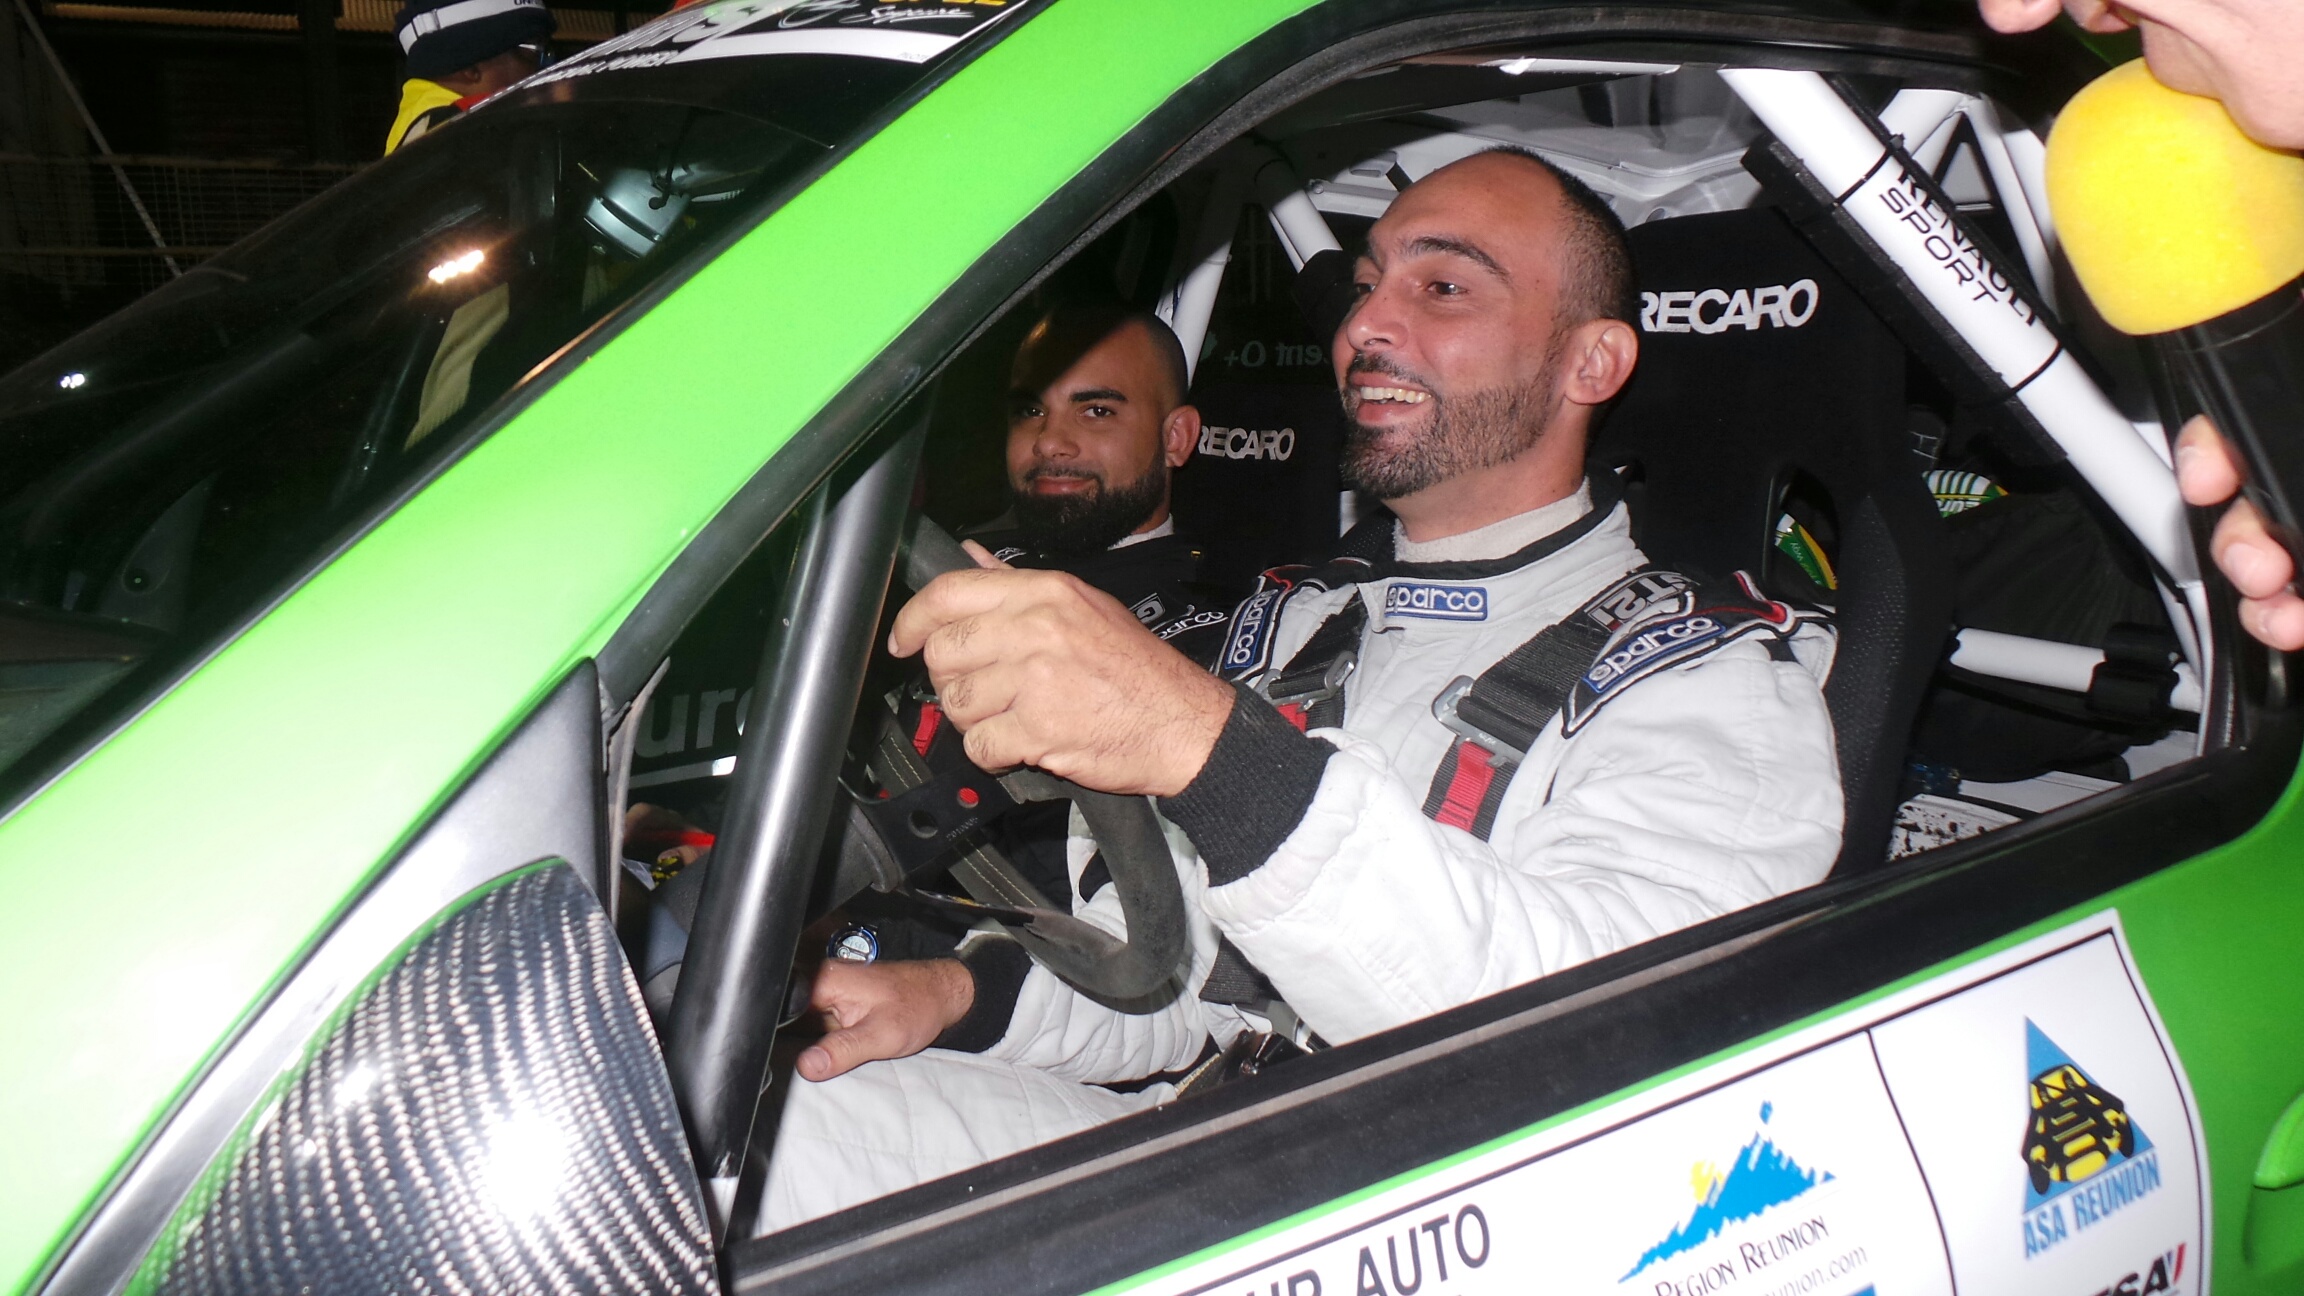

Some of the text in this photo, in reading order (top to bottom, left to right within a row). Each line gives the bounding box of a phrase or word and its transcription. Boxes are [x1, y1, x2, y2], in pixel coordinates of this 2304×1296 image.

[1879, 187, 1999, 302] SPORT
[1640, 278, 1819, 334] RECARO
[1198, 425, 1295, 461] RECARO
[1387, 585, 1484, 614] sparco
[1589, 616, 1716, 685] sparco
[2023, 1152, 2161, 1260] ASA REUNION
[1356, 1203, 1490, 1296] AUTO
[1739, 1215, 1829, 1273] REUNION
